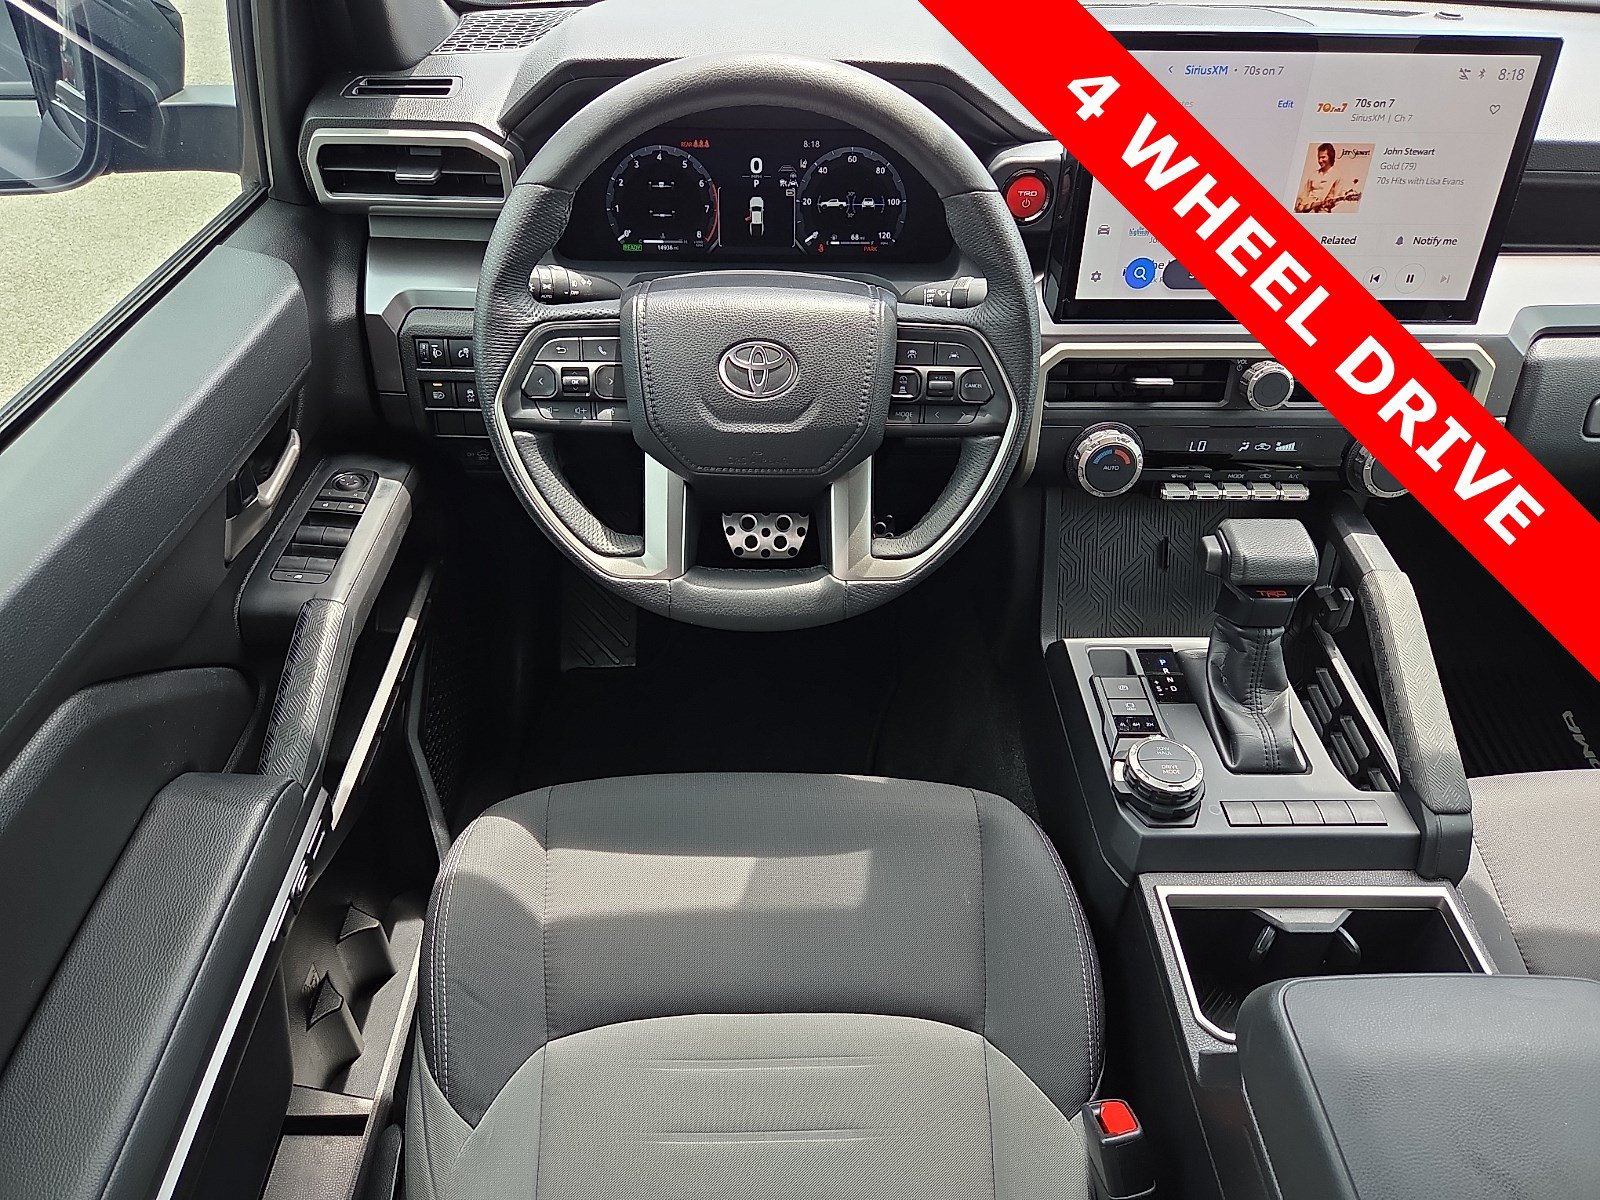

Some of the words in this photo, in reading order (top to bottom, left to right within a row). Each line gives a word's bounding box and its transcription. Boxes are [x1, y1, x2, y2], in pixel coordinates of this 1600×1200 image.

[1185, 65, 1229, 76] SiriusXM
[1243, 65, 1260, 76] 70s
[1262, 67, 1275, 76] on
[1278, 66, 1284, 76] 7
[1497, 68, 1525, 82] 8:18
[1277, 100, 1294, 108] Edit
[1355, 98, 1371, 108] 70s
[1373, 100, 1386, 108] on
[1388, 99, 1395, 108] 7
[1351, 113, 1385, 122] SiriusXM
[1394, 113, 1405, 122] Ch
[1407, 114, 1413, 122] 7
[803, 140, 820, 149] 8:18
[1383, 147, 1402, 155] John
[1403, 147, 1435, 156] Stewart
[656, 153, 663, 161] 4
[847, 155, 858, 163] 60
[633, 160, 640, 169] 3
[681, 160, 688, 169] 5
[1379, 162, 1399, 170] Gold
[1400, 162, 1417, 171] (79)
[818, 166, 828, 174] 40
[875, 166, 886, 175] 80
[618, 179, 624, 187] 2
[698, 179, 705, 188] 6
[753, 180, 760, 188] P
[1376, 176, 1389, 185] 70s
[1390, 176, 1406, 185] Hits
[1407, 176, 1424, 185] with
[1425, 177, 1440, 185] Lisa
[1441, 177, 1464, 186] Evans
[802, 197, 812, 205] 20
[887, 198, 901, 206] 100
[614, 204, 620, 213] 1
[704, 204, 710, 213] 7
[696, 230, 702, 239] 8
[878, 232, 891, 240] 120
[1320, 235, 1357, 246] Related
[1412, 235, 1441, 247] Notify
[1443, 237, 1458, 246] me
[1188, 440, 1207, 452] LO
[1255, 590, 1287, 598] TRD
